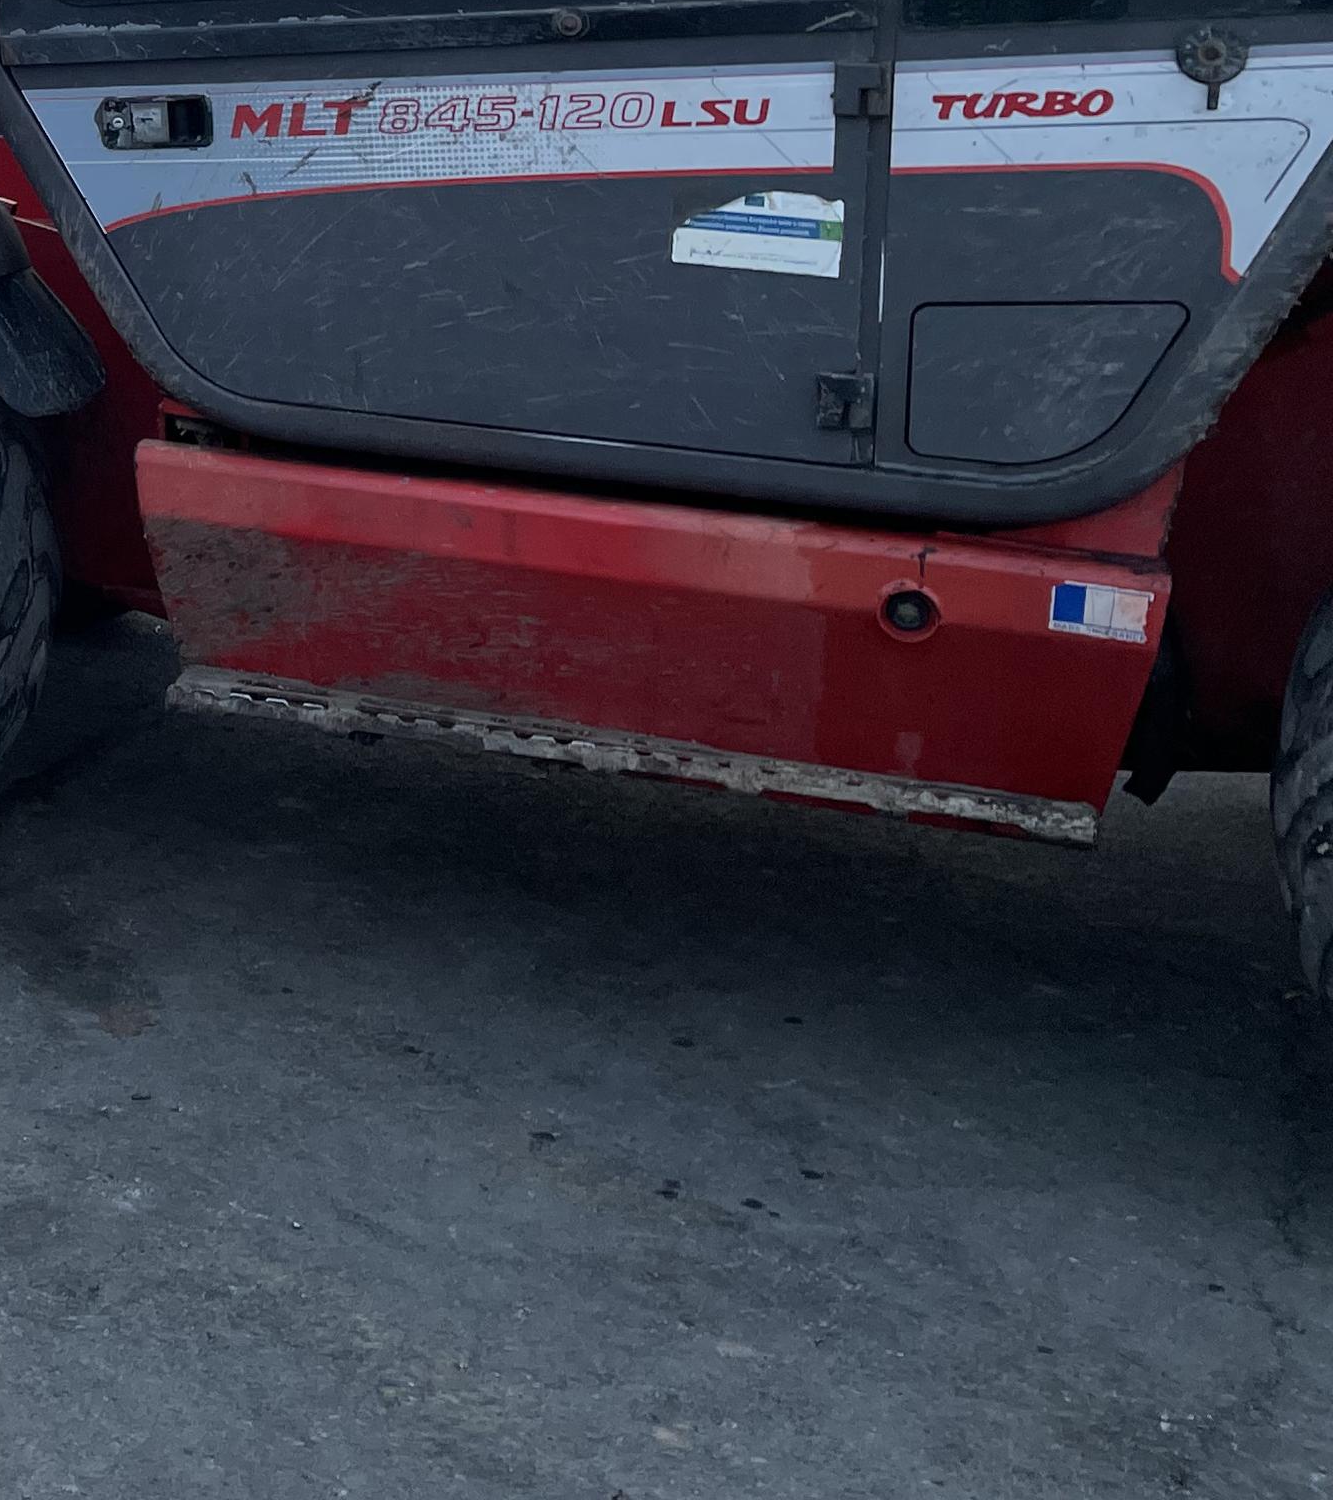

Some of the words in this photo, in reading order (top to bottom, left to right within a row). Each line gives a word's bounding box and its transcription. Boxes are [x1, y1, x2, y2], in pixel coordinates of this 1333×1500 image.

[231, 100, 370, 139] MLT
[379, 92, 654, 134] 845-120
[660, 98, 770, 128] LSU
[932, 89, 1114, 121] TURBO
